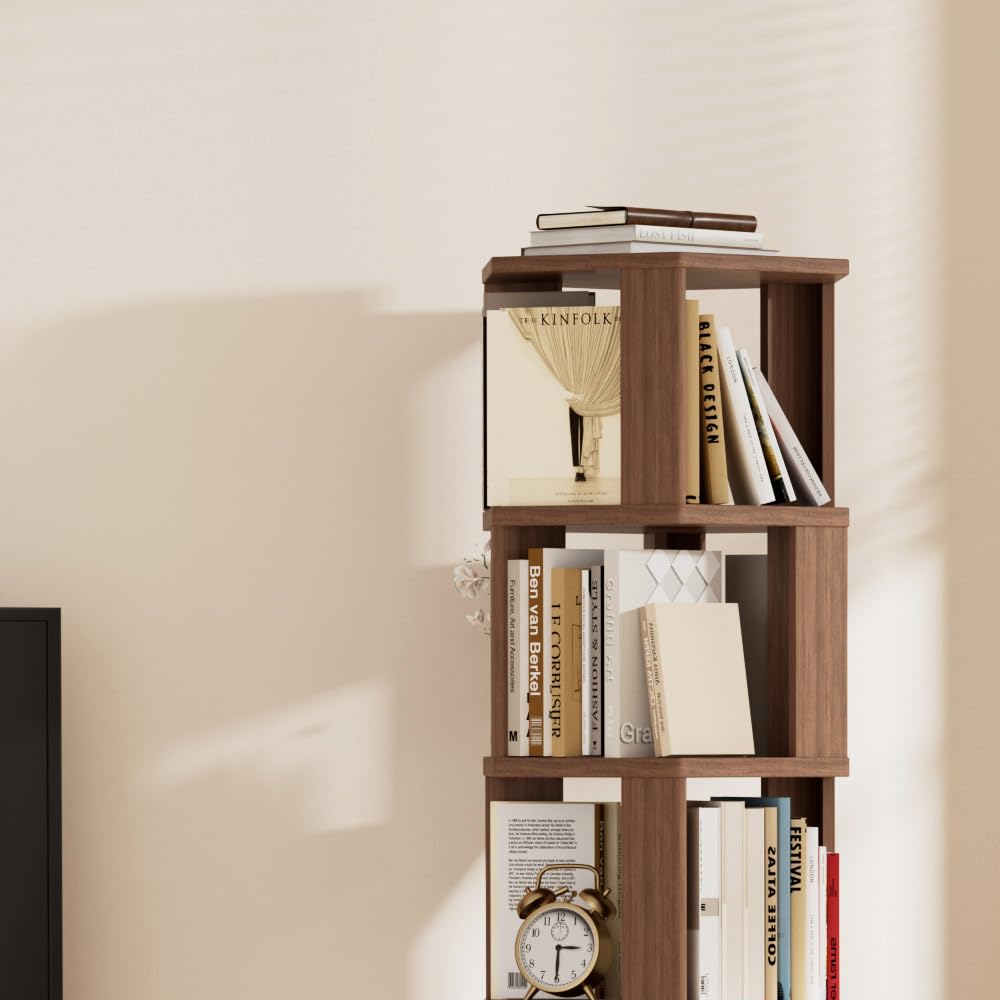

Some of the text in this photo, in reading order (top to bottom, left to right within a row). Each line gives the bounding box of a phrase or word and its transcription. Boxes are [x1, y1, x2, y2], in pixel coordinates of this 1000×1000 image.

[541, 312, 612, 326] KINFOLK
[726, 356, 737, 383] LONDON
[699, 321, 720, 444] BLACK DESIGN
[529, 565, 541, 696] Ben van Berkel
[592, 639, 598, 650] &
[606, 655, 615, 682] Art
[509, 730, 518, 742] M
[620, 722, 653, 745] Gra
[791, 826, 802, 893] FESTIVAL
[544, 916, 551, 926] 11
[557, 912, 566, 922] 12
[531, 928, 540, 937] 10
[583, 928, 589, 937] 2
[525, 944, 532, 953] 9
[586, 943, 593, 952] 3
[528, 960, 535, 968] 8
[580, 959, 586, 968] 4
[540, 970, 546, 979] 7
[571, 970, 577, 979] 5
